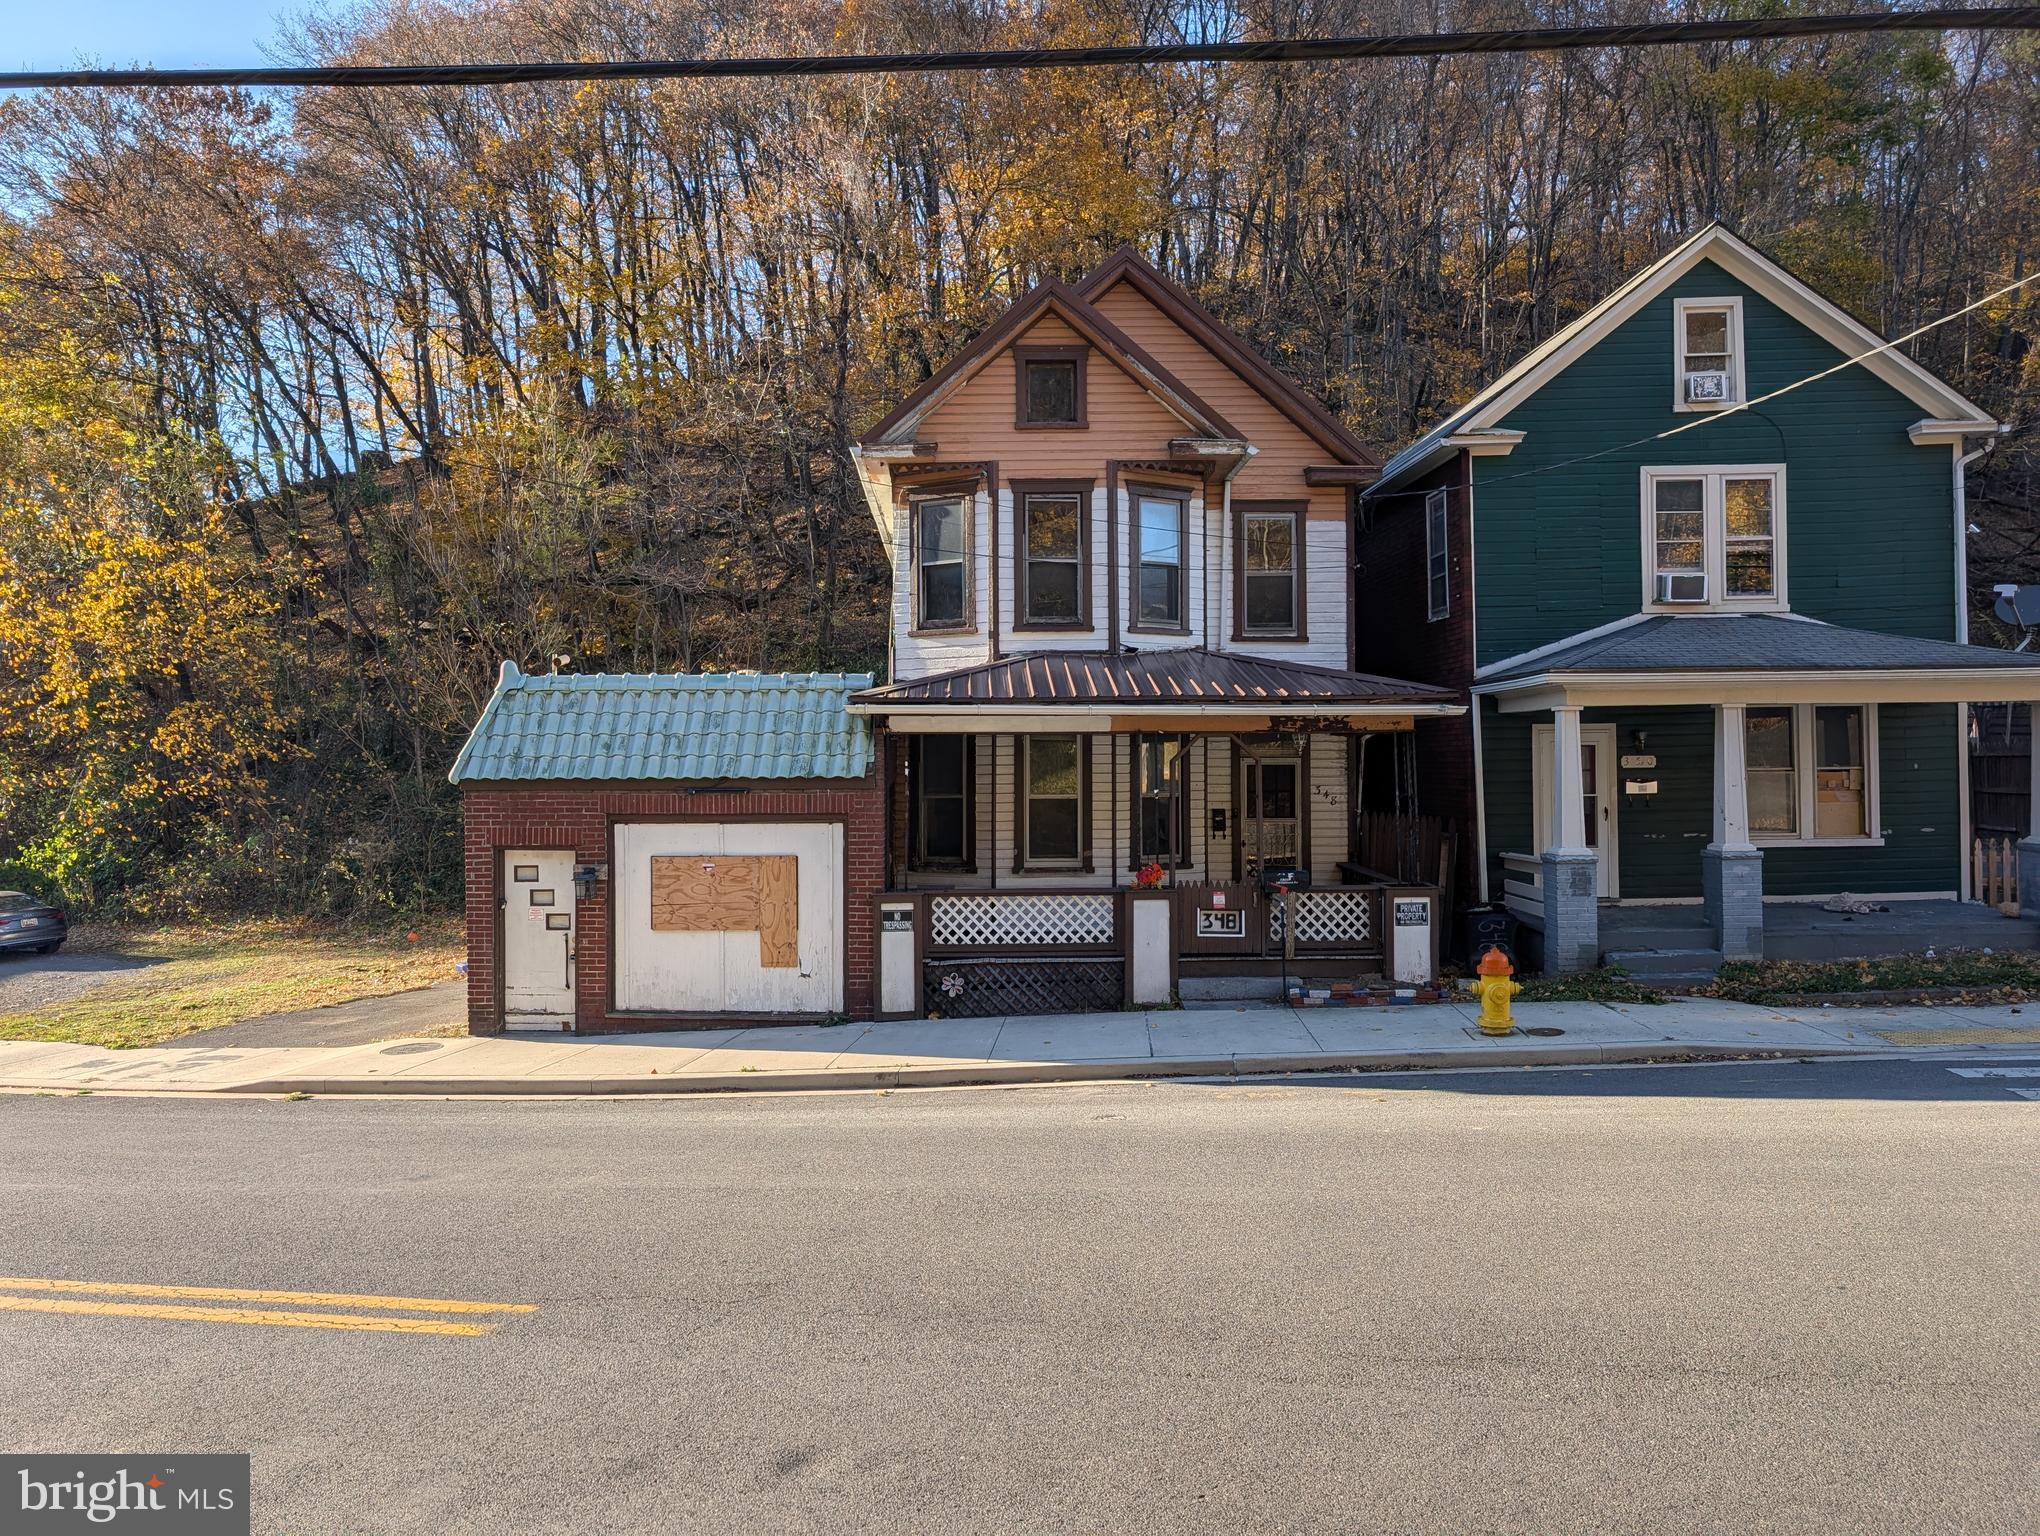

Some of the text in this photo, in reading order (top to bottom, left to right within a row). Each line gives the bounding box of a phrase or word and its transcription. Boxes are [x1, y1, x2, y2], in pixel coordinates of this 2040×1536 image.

[1313, 785, 1337, 806] 348
[1400, 904, 1423, 913] PRIVATE
[894, 912, 901, 921] NO
[1396, 912, 1427, 921] PROPERTY
[883, 920, 912, 930] TRESPASSING
[1203, 913, 1237, 930] 348
